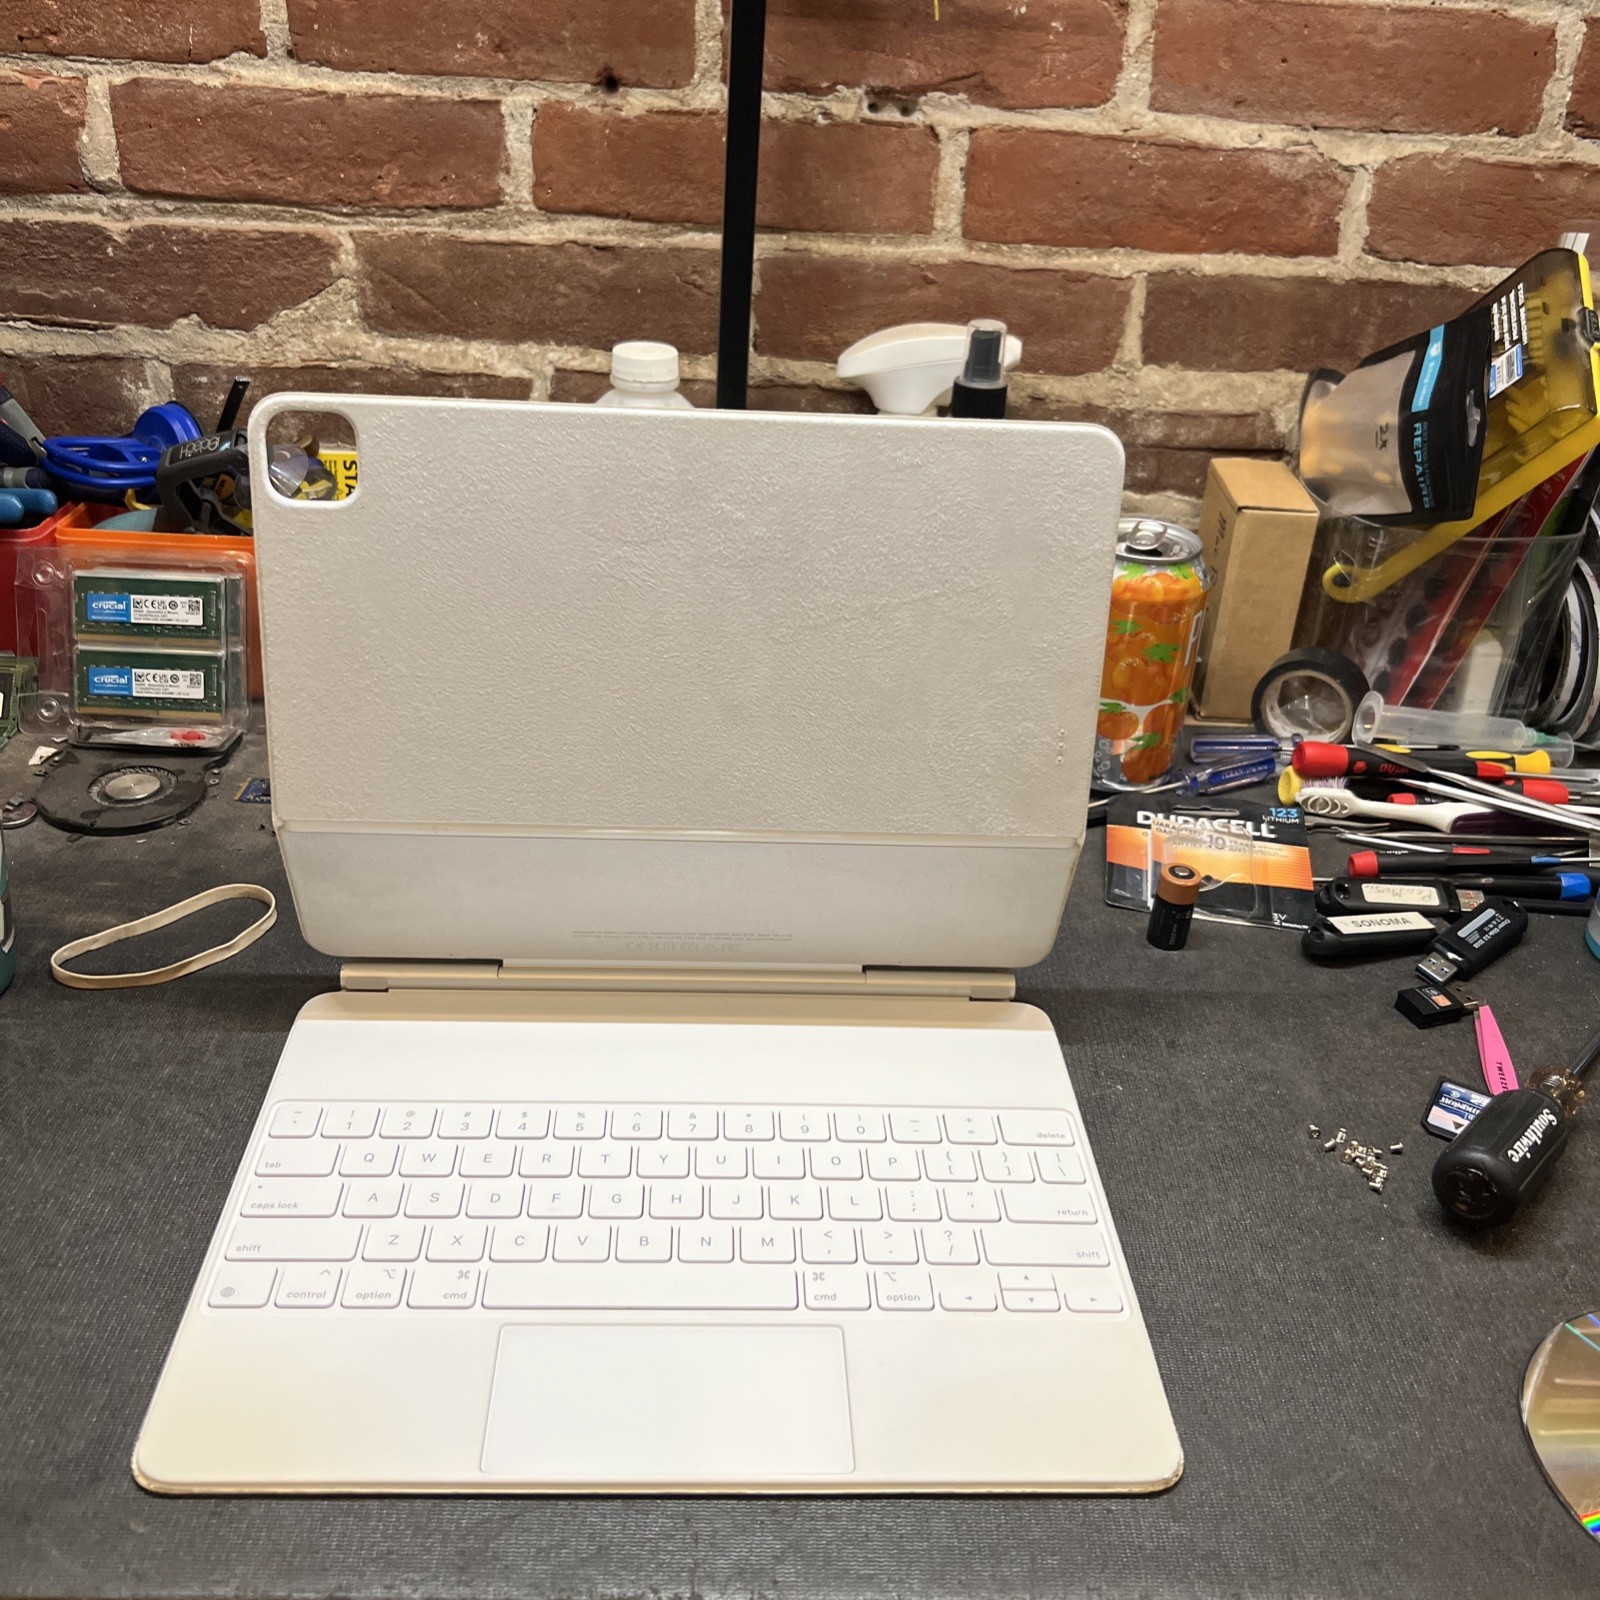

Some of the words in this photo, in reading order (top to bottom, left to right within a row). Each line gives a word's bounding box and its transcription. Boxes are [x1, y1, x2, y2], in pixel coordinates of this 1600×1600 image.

[92, 601, 126, 610] crucial
[94, 674, 128, 684] crucial
[1269, 807, 1298, 817] 123
[1136, 811, 1277, 838] DURACELL
[1262, 816, 1299, 824] LITHIUM
[1272, 913, 1286, 921] 3V
[1350, 917, 1412, 928] SONOMA
[1496, 1061, 1509, 1091] TWEEZE
[401, 1121, 412, 1131] 2
[460, 1121, 470, 1131] 3
[517, 1122, 527, 1131] 4
[575, 1122, 585, 1132] 5
[632, 1122, 642, 1132] 6
[688, 1123, 698, 1133] 7
[744, 1123, 754, 1134] 8
[800, 1124, 810, 1134] 9
[856, 1125, 866, 1135] 0
[1036, 1131, 1066, 1140] delete
[1507, 1108, 1558, 1163] Southwire
[264, 1160, 282, 1169] tab
[363, 1152, 375, 1163] Q
[422, 1152, 437, 1163] W
[483, 1153, 493, 1164] E
[541, 1153, 552, 1163] R
[600, 1153, 611, 1164] T
[659, 1154, 669, 1164] Y
[716, 1154, 727, 1165] U
[830, 1155, 842, 1166] O
[888, 1157, 898, 1167] P
[250, 1202, 276, 1212] caps
[278, 1201, 299, 1210] lock
[367, 1192, 379, 1203] A
[429, 1192, 441, 1203] S
[489, 1193, 502, 1204] D
[551, 1192, 561, 1204] F
[611, 1193, 622, 1204] G
[671, 1193, 682, 1204] H
[732, 1194, 741, 1205] J
[790, 1194, 801, 1205] K
[850, 1195, 859, 1206] L
[1056, 1209, 1089, 1217] return
[235, 1243, 262, 1253] shift
[388, 1234, 400, 1246] Z
[450, 1234, 464, 1246] X
[514, 1235, 526, 1247] C
[577, 1235, 589, 1247] V
[639, 1235, 650, 1247] B
[700, 1236, 712, 1247] N
[761, 1236, 775, 1248] M
[1075, 1250, 1101, 1259] shift
[286, 1290, 327, 1299] control
[355, 1290, 392, 1301] option
[442, 1290, 468, 1300] cmd
[813, 1292, 837, 1301] cmd
[886, 1292, 921, 1303] option
